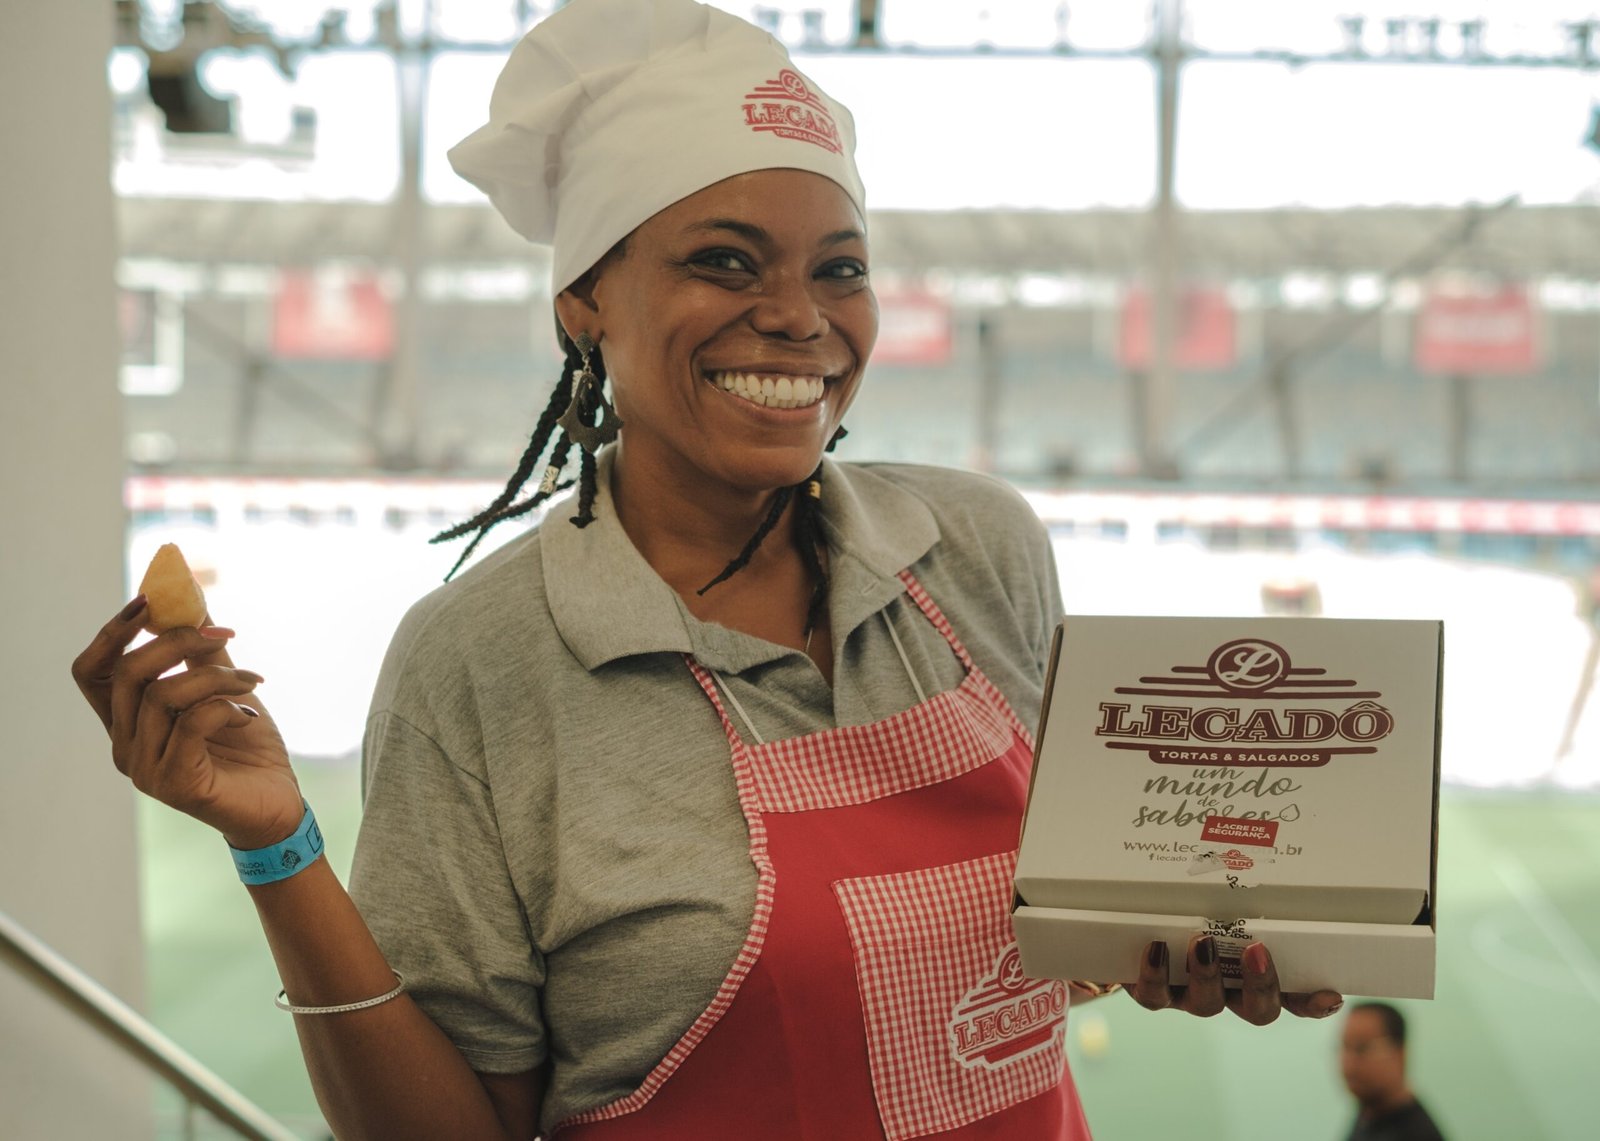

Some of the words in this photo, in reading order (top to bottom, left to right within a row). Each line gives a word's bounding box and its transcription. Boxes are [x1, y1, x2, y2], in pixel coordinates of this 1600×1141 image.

[1095, 700, 1394, 742] LECADÔ
[1160, 750, 1218, 761] TORTAS
[1223, 753, 1232, 761] &
[1238, 753, 1320, 762] SALGADOS
[1193, 767, 1244, 780] um
[1143, 767, 1302, 798] mundo
[1197, 796, 1220, 807] de
[1216, 822, 1249, 831] LACRE
[1207, 827, 1271, 839] SEGURANÇA
[954, 979, 1065, 1055] LECADÔ
